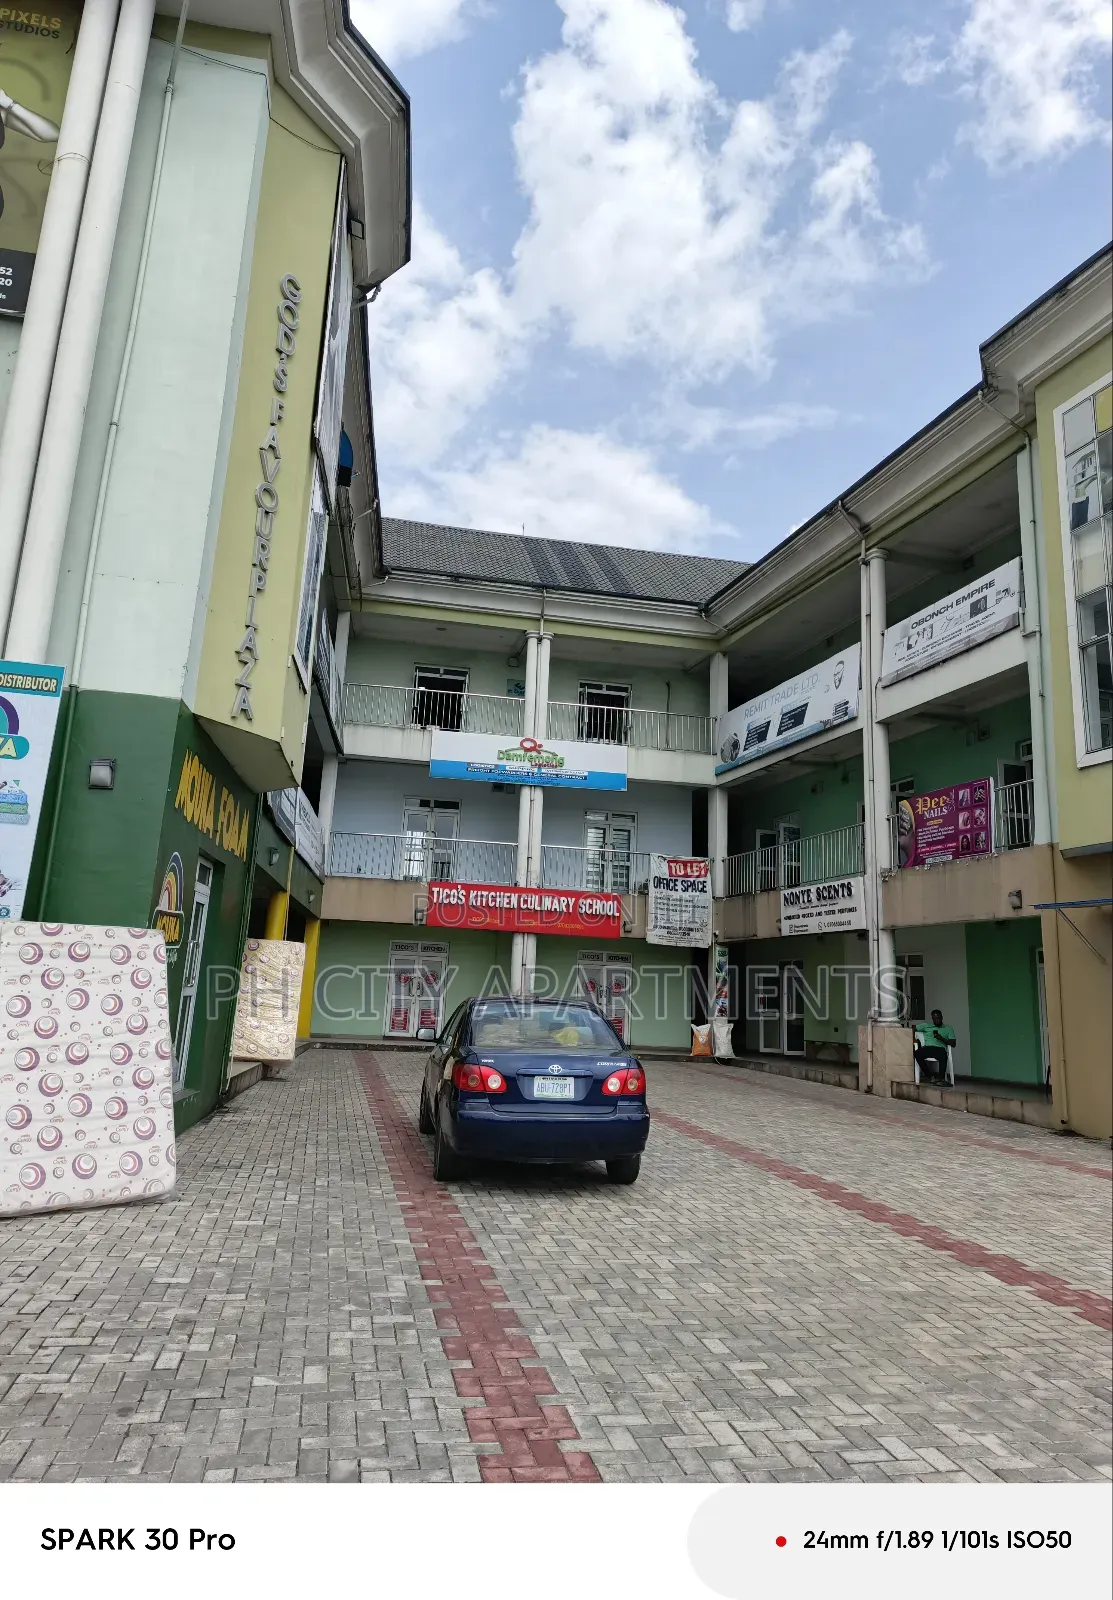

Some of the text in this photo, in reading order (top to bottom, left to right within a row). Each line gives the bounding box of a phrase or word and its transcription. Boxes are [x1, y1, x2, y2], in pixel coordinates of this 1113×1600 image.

[0, 7, 62, 29] PIXELS
[0, 20, 60, 39] STUDIOS
[231, 273, 302, 721] GOD'S FAVOUR PLAZA
[911, 578, 996, 630] OBONCH EMPIRE
[744, 698, 769, 721] REMIT
[769, 683, 799, 706] TRADE
[215, 786, 250, 863] FOAM
[924, 806, 948, 819] NAILS
[670, 863, 705, 876] TO LET
[653, 876, 707, 893] OFFICE SPACE
[783, 889, 812, 906] NONYE
[816, 881, 853, 901] SCENTS
[432, 885, 620, 917] TICO'S KITCHEN CULINARY SCHOOL
